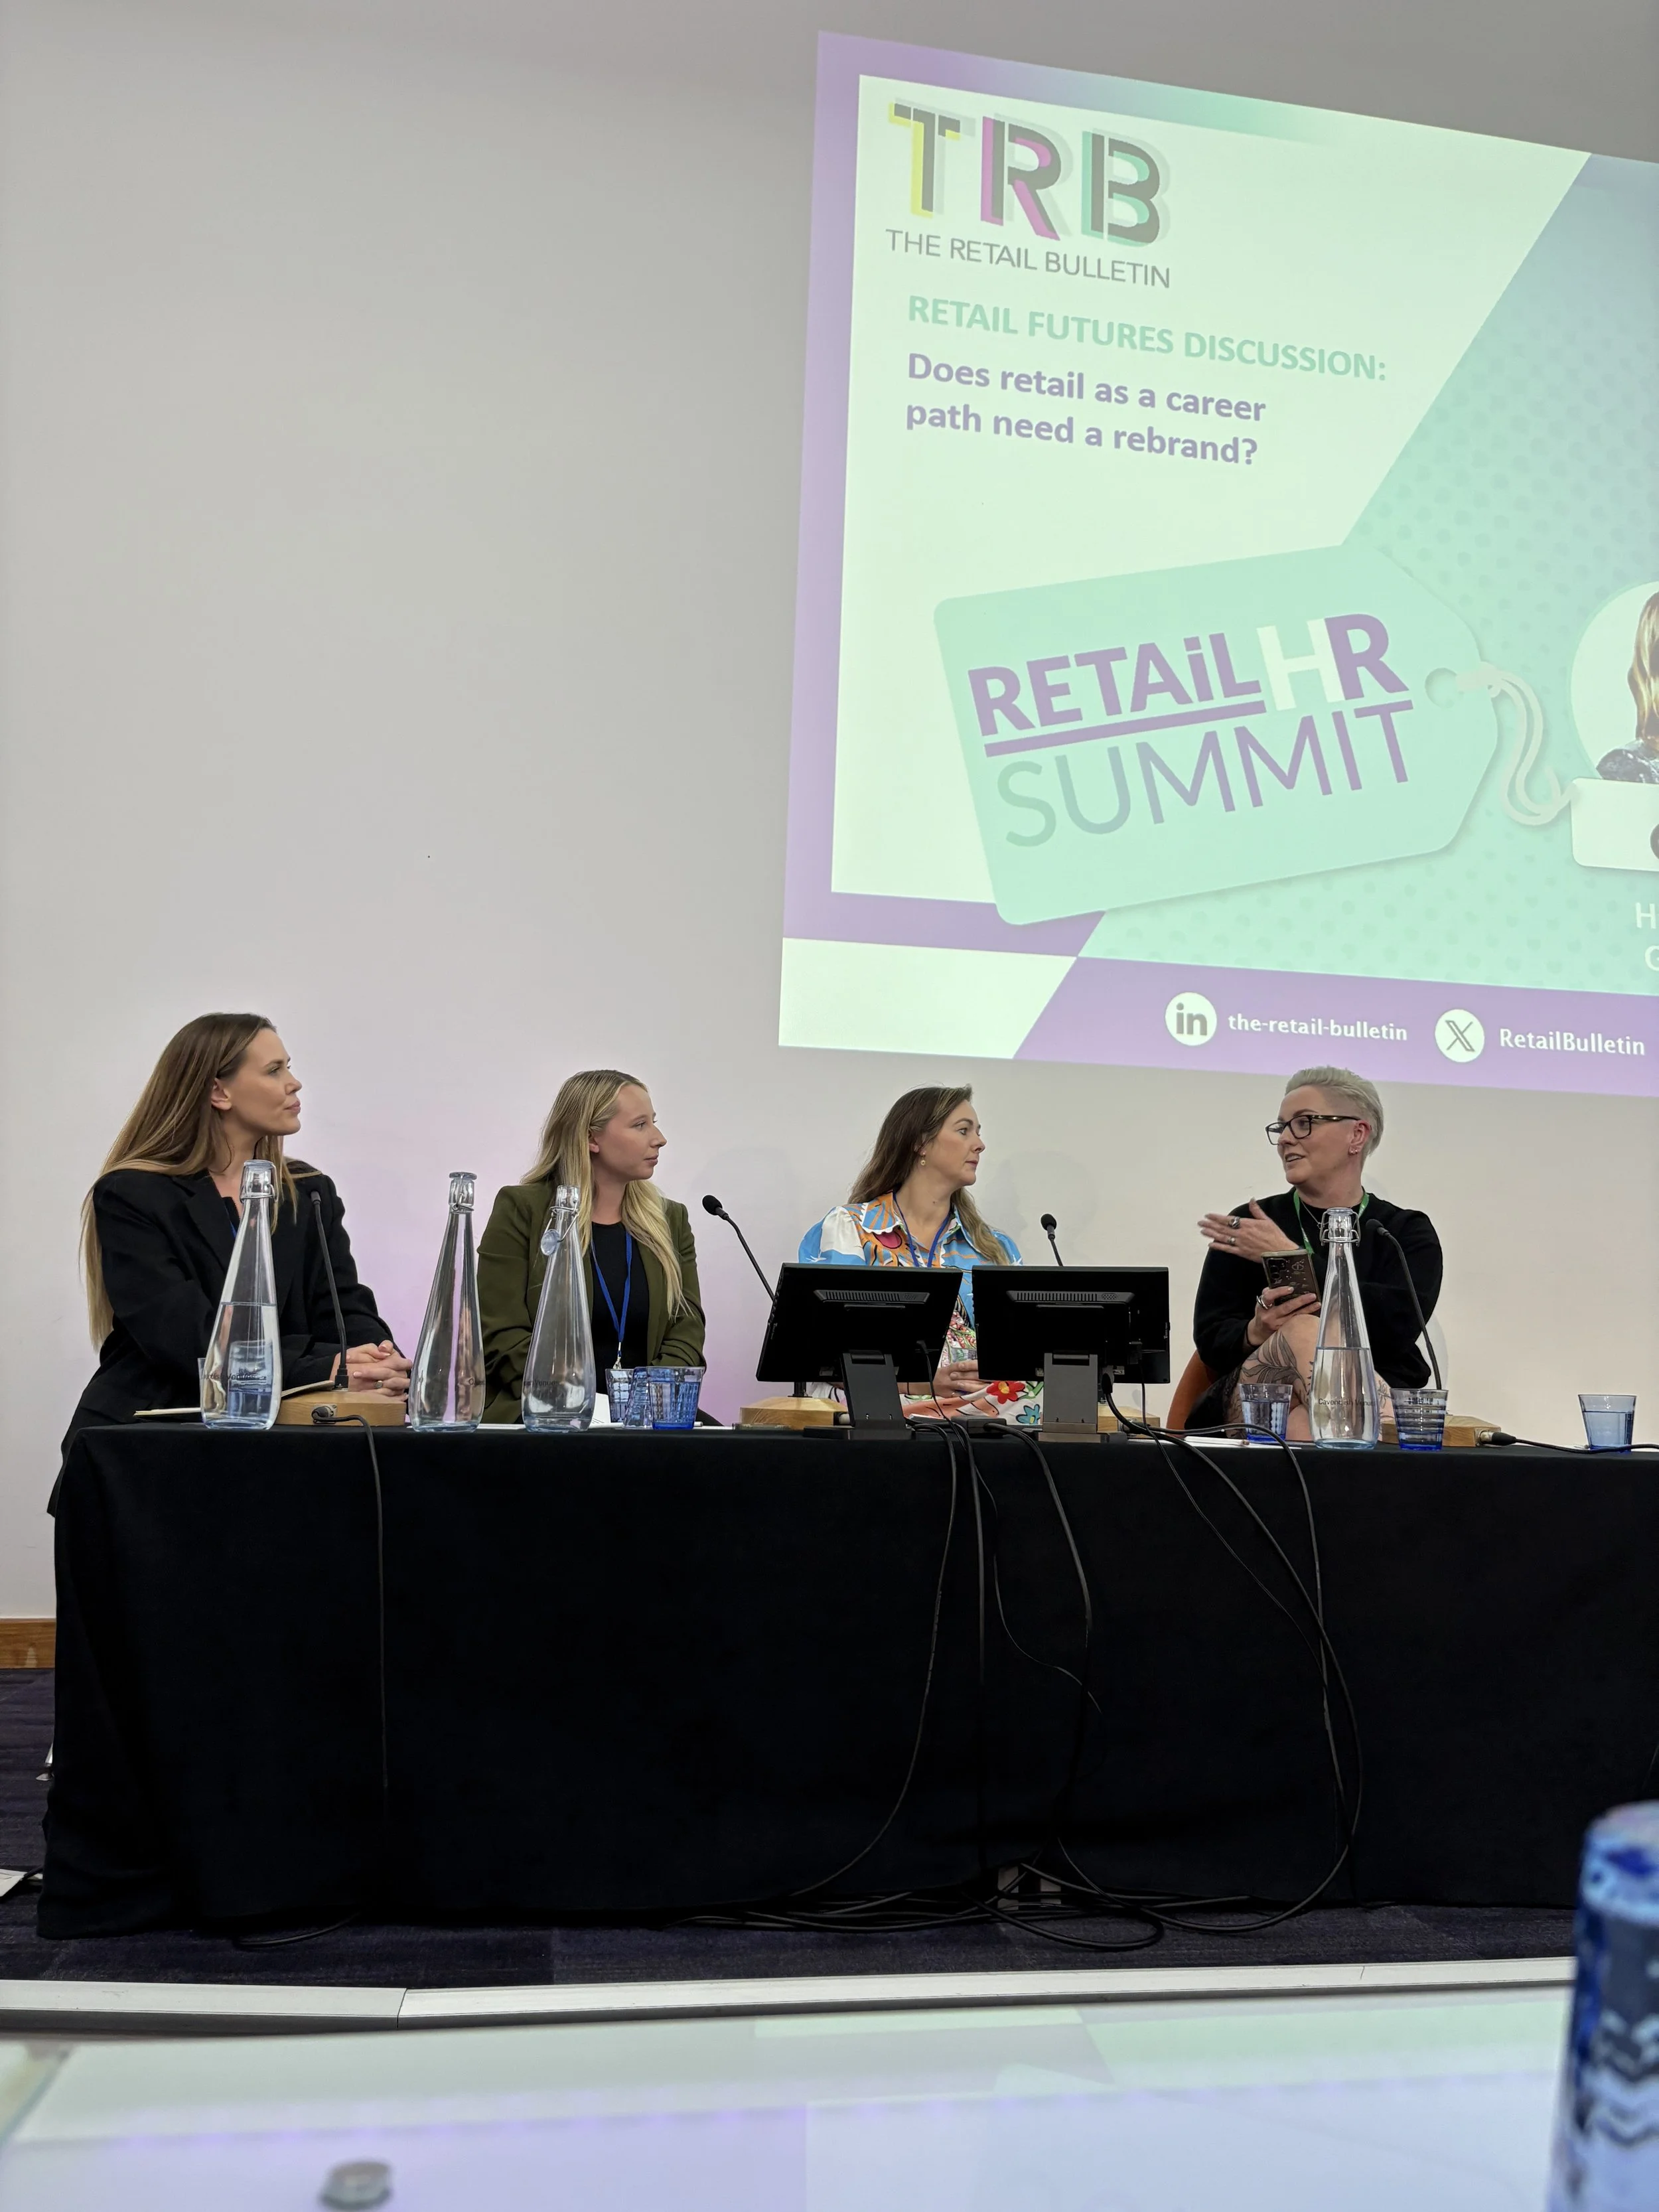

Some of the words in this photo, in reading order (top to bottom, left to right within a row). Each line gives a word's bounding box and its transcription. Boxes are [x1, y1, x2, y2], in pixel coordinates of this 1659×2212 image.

[889, 98, 1171, 248] TRB
[885, 228, 941, 257] THE
[950, 237, 1037, 271] RETAIL
[1045, 251, 1170, 289] BULLETIN
[908, 295, 1019, 334] RETAIL
[1028, 311, 1174, 354] FUTURES
[1185, 332, 1386, 381] DISCUSSION:
[908, 352, 990, 388] Does
[1001, 370, 1084, 400] retail
[1094, 383, 1129, 405] as
[1138, 388, 1156, 408] a
[1166, 392, 1266, 421] career
[906, 404, 981, 433] path
[993, 416, 1074, 444] need
[1085, 426, 1102, 447] a
[1114, 426, 1258, 465] rebrand?
[997, 699, 1413, 848] SUMMIT
[1176, 1002, 1208, 1036] in
[1228, 1013, 1407, 1041] the-retail-bulletin
[1500, 1028, 1645, 1056] RetailBulletin
